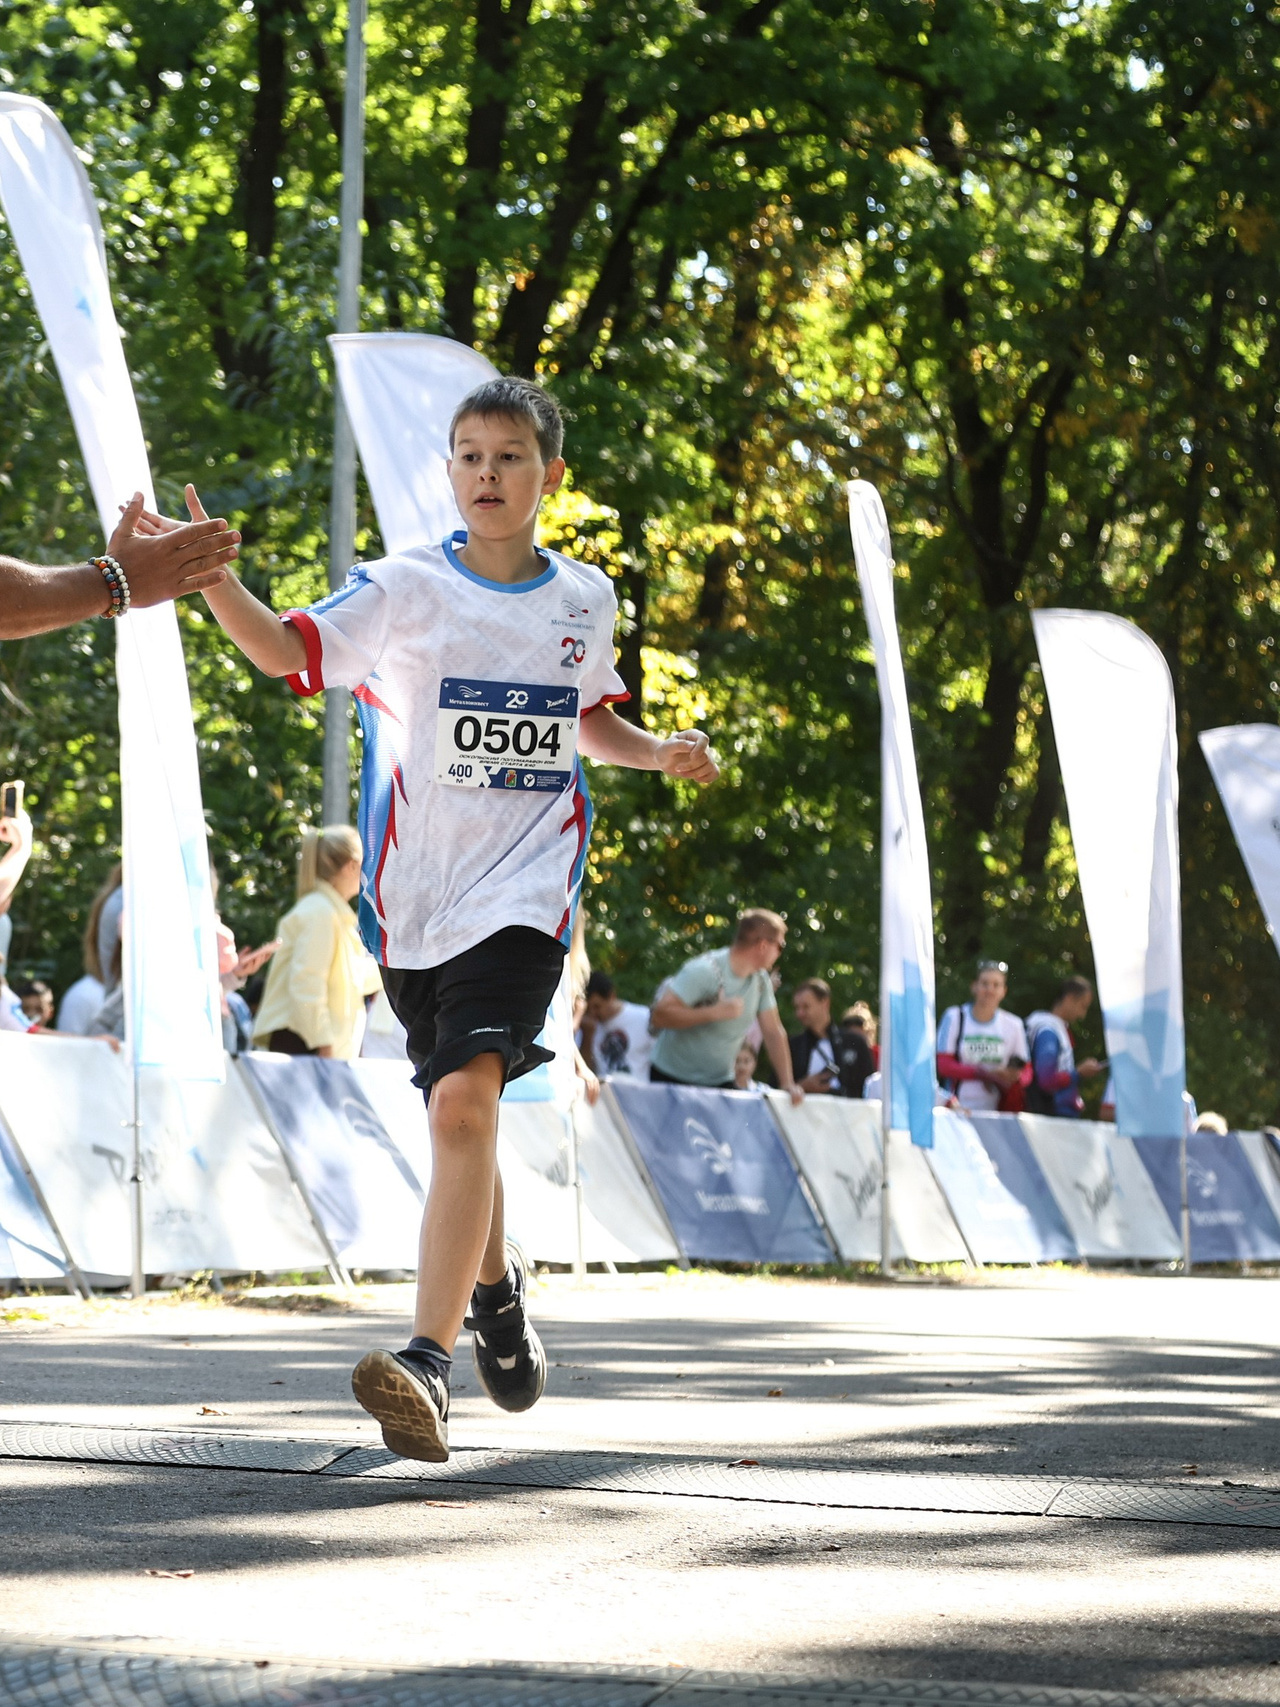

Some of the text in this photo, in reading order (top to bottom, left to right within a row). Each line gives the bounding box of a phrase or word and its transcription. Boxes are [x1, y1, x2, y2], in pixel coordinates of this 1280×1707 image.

[560, 637, 586, 669] 20
[505, 689, 529, 709] 20
[453, 715, 561, 757] 0504
[448, 764, 473, 778] 400
